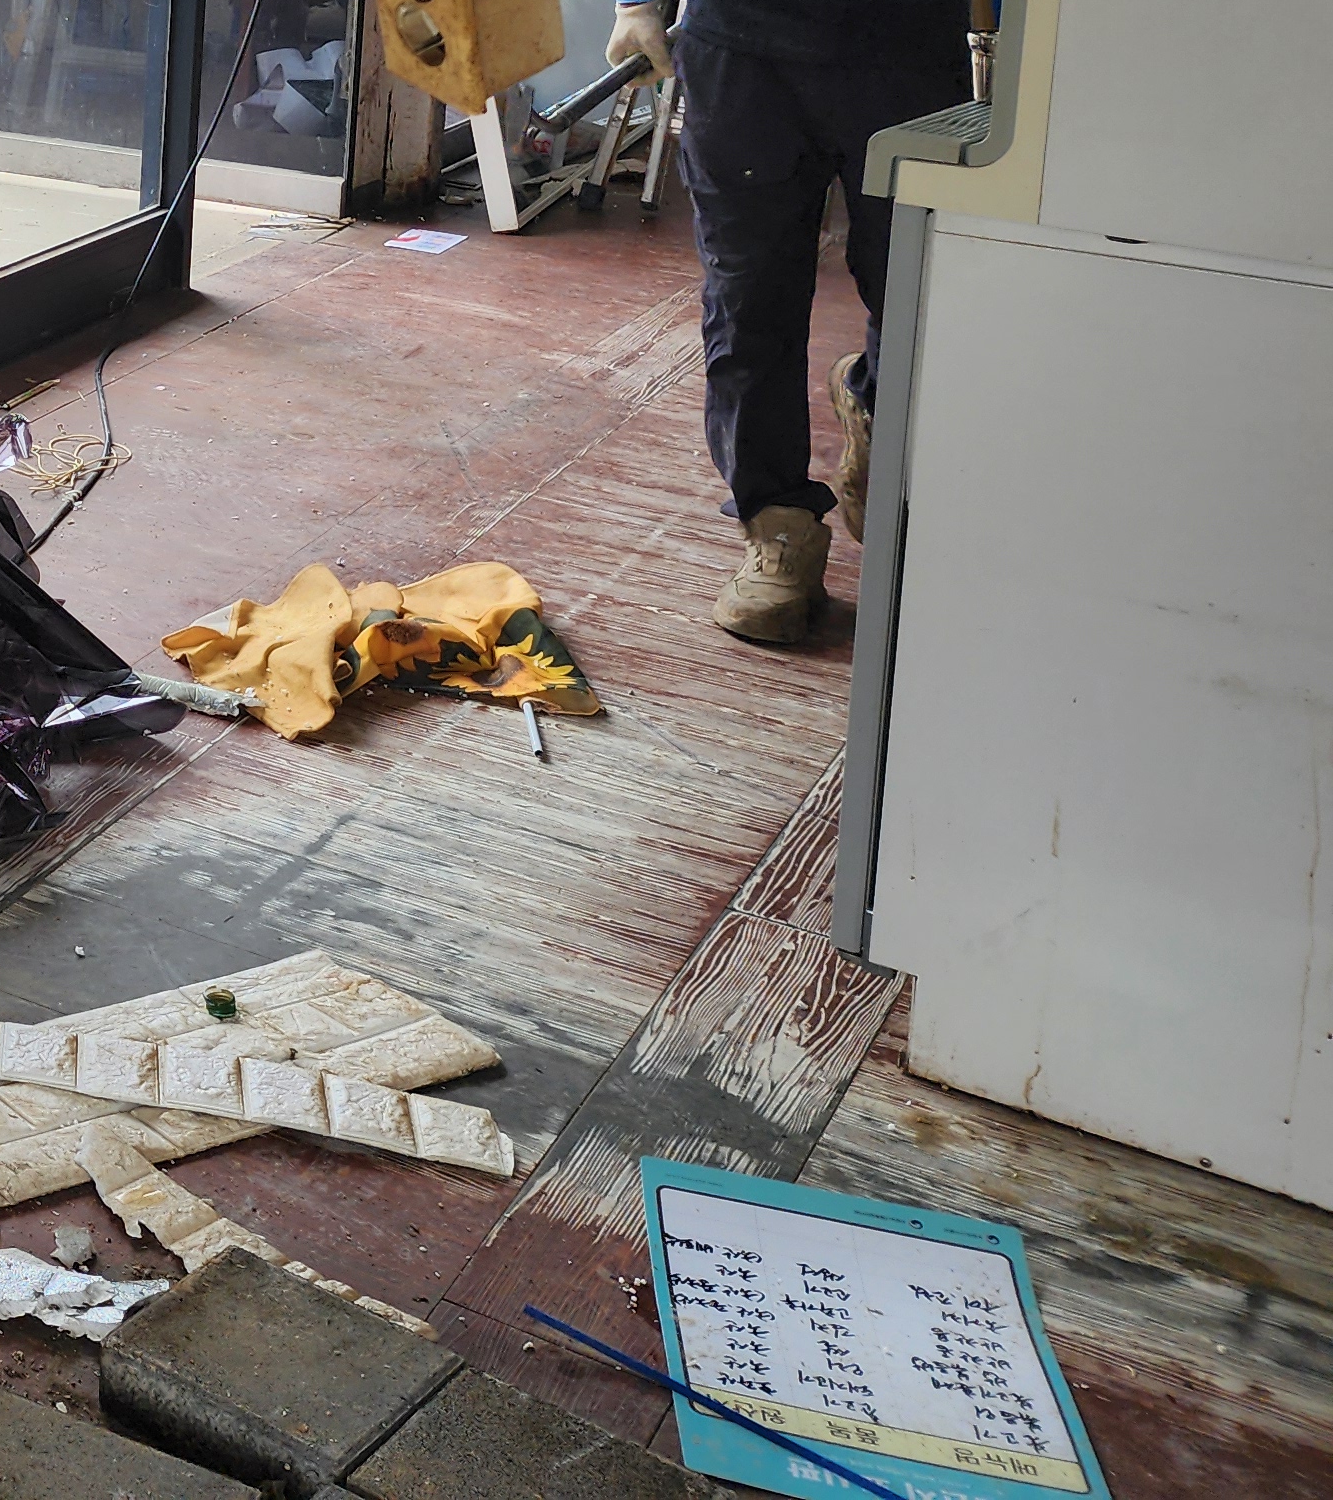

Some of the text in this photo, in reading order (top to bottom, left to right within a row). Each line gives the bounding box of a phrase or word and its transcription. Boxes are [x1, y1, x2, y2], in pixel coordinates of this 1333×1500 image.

[796, 1263, 846, 1282] 생선
[810, 1318, 856, 1339] 김치
[826, 1358, 864, 1377] 오리
[706, 1394, 1038, 1476] 메뉴명 품목 원산
